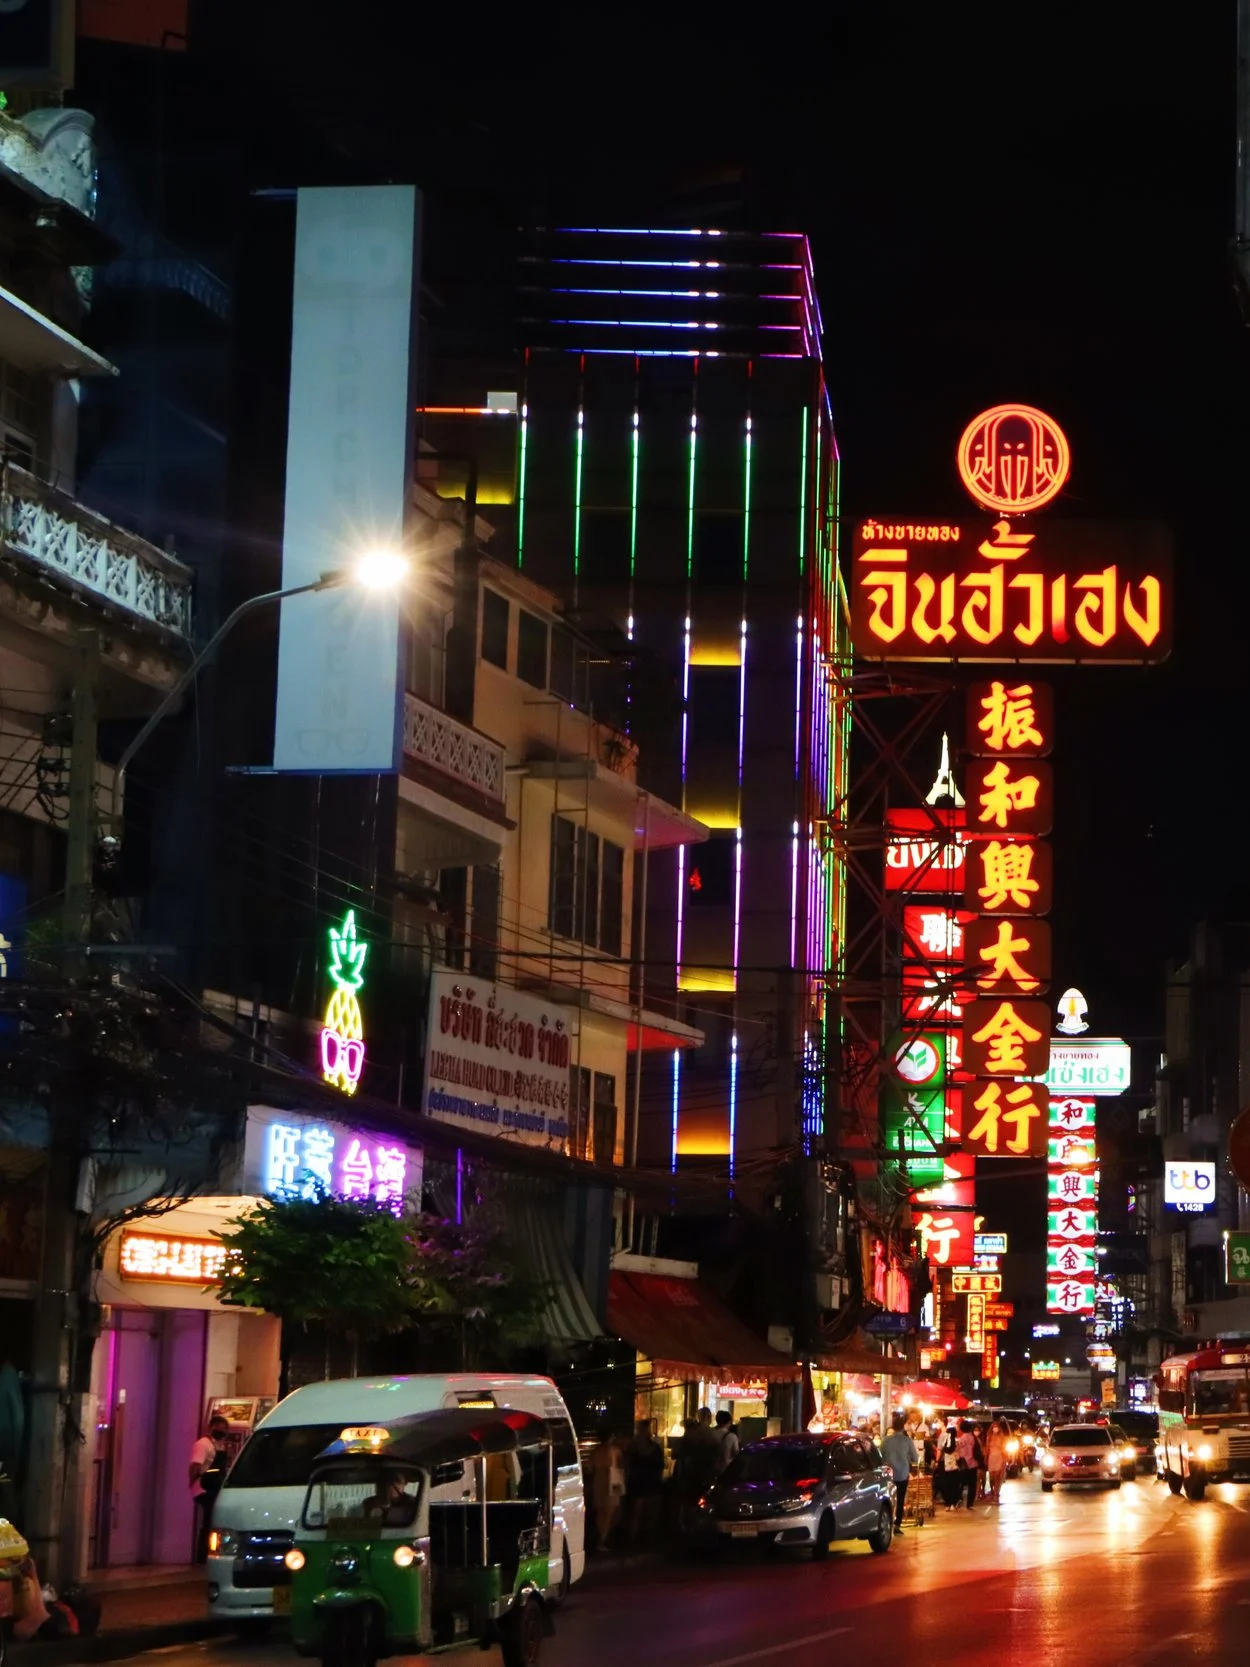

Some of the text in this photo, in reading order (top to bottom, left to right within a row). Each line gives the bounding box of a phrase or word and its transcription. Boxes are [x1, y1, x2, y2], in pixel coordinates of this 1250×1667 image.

[861, 519, 960, 543] ห้างขายทอง
[1169, 1169, 1211, 1190] ttb
[1183, 1203, 1204, 1212] 1428
[350, 1429, 378, 1438] TAXI
